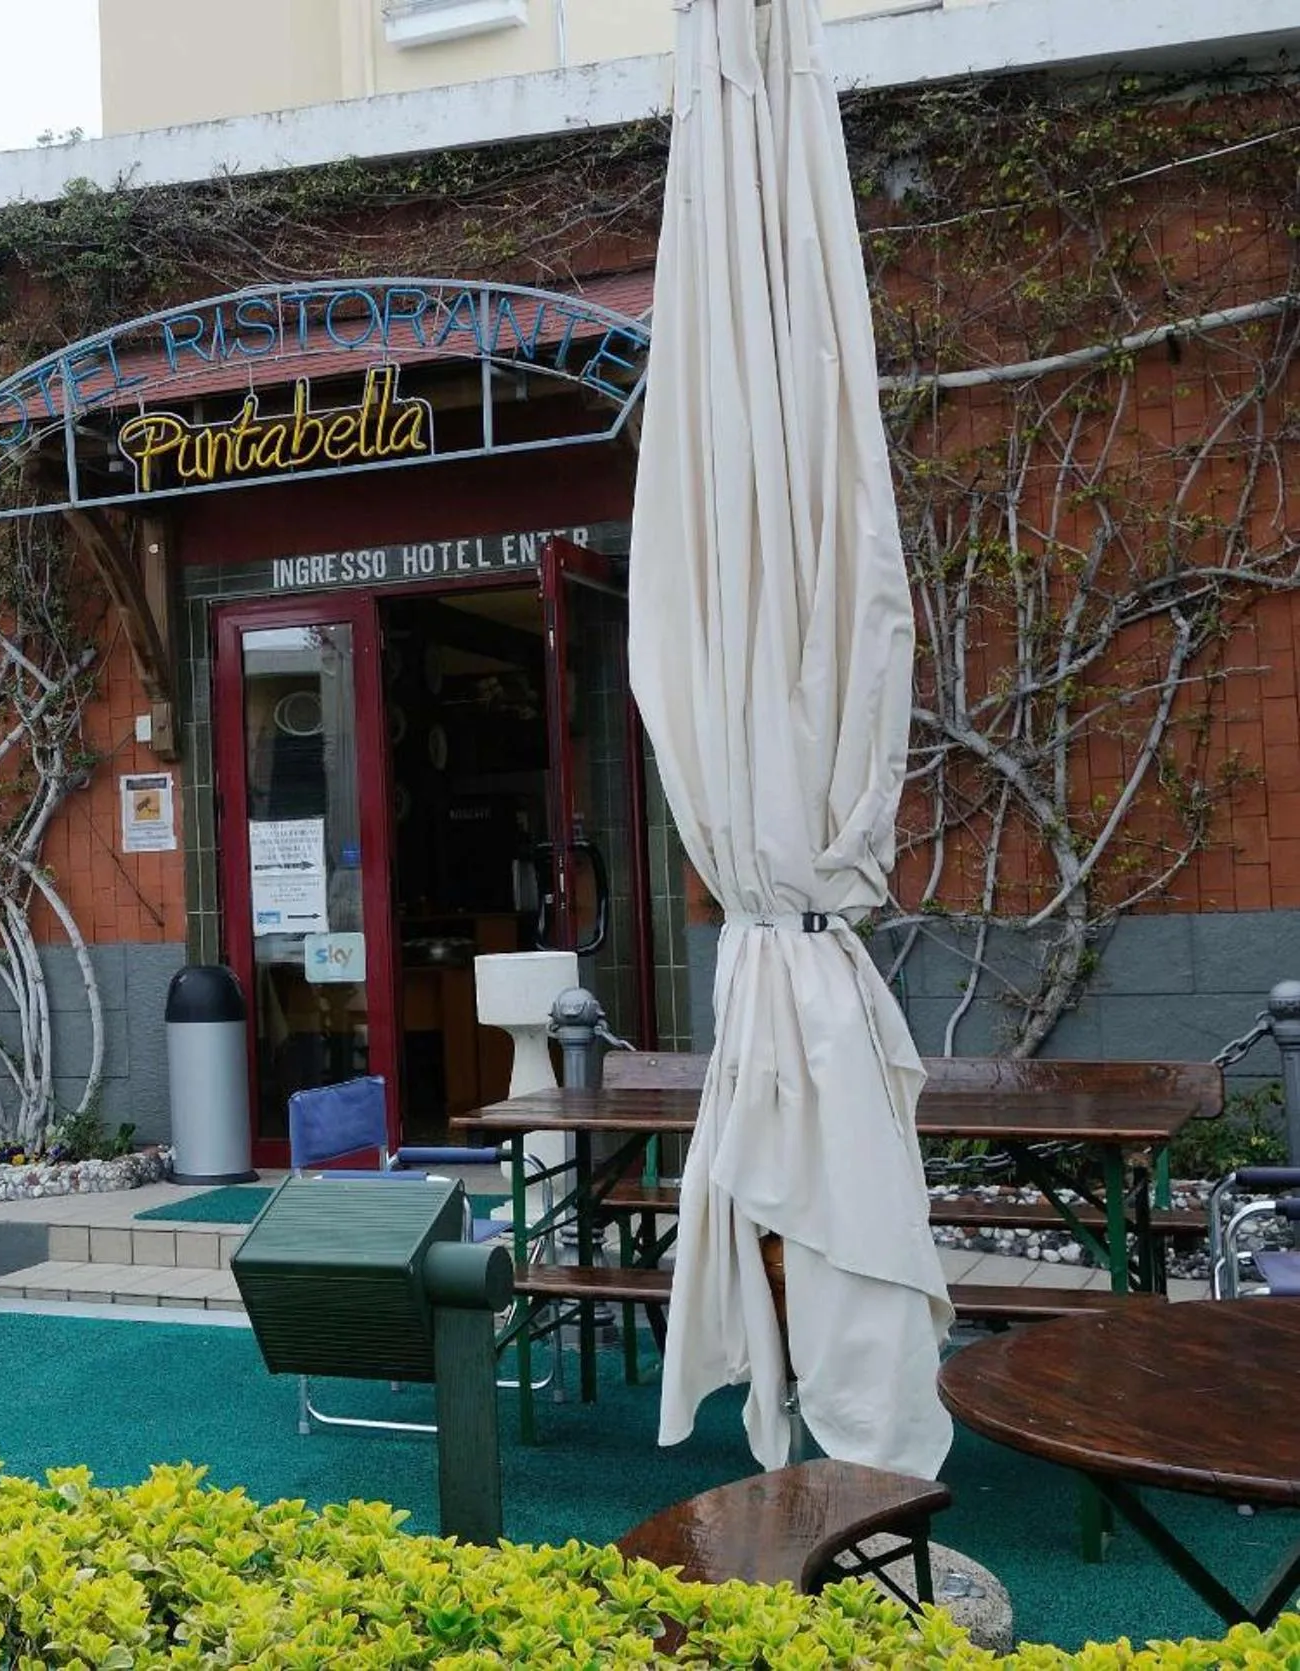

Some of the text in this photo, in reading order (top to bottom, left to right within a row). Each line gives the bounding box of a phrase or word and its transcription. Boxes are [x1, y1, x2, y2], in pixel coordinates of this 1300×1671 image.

[163, 288, 649, 398] RISTORANTE
[122, 366, 428, 492] Puntabella
[273, 527, 589, 588] INGRESSO HOTEL ENTR
[315, 944, 353, 969] sky
